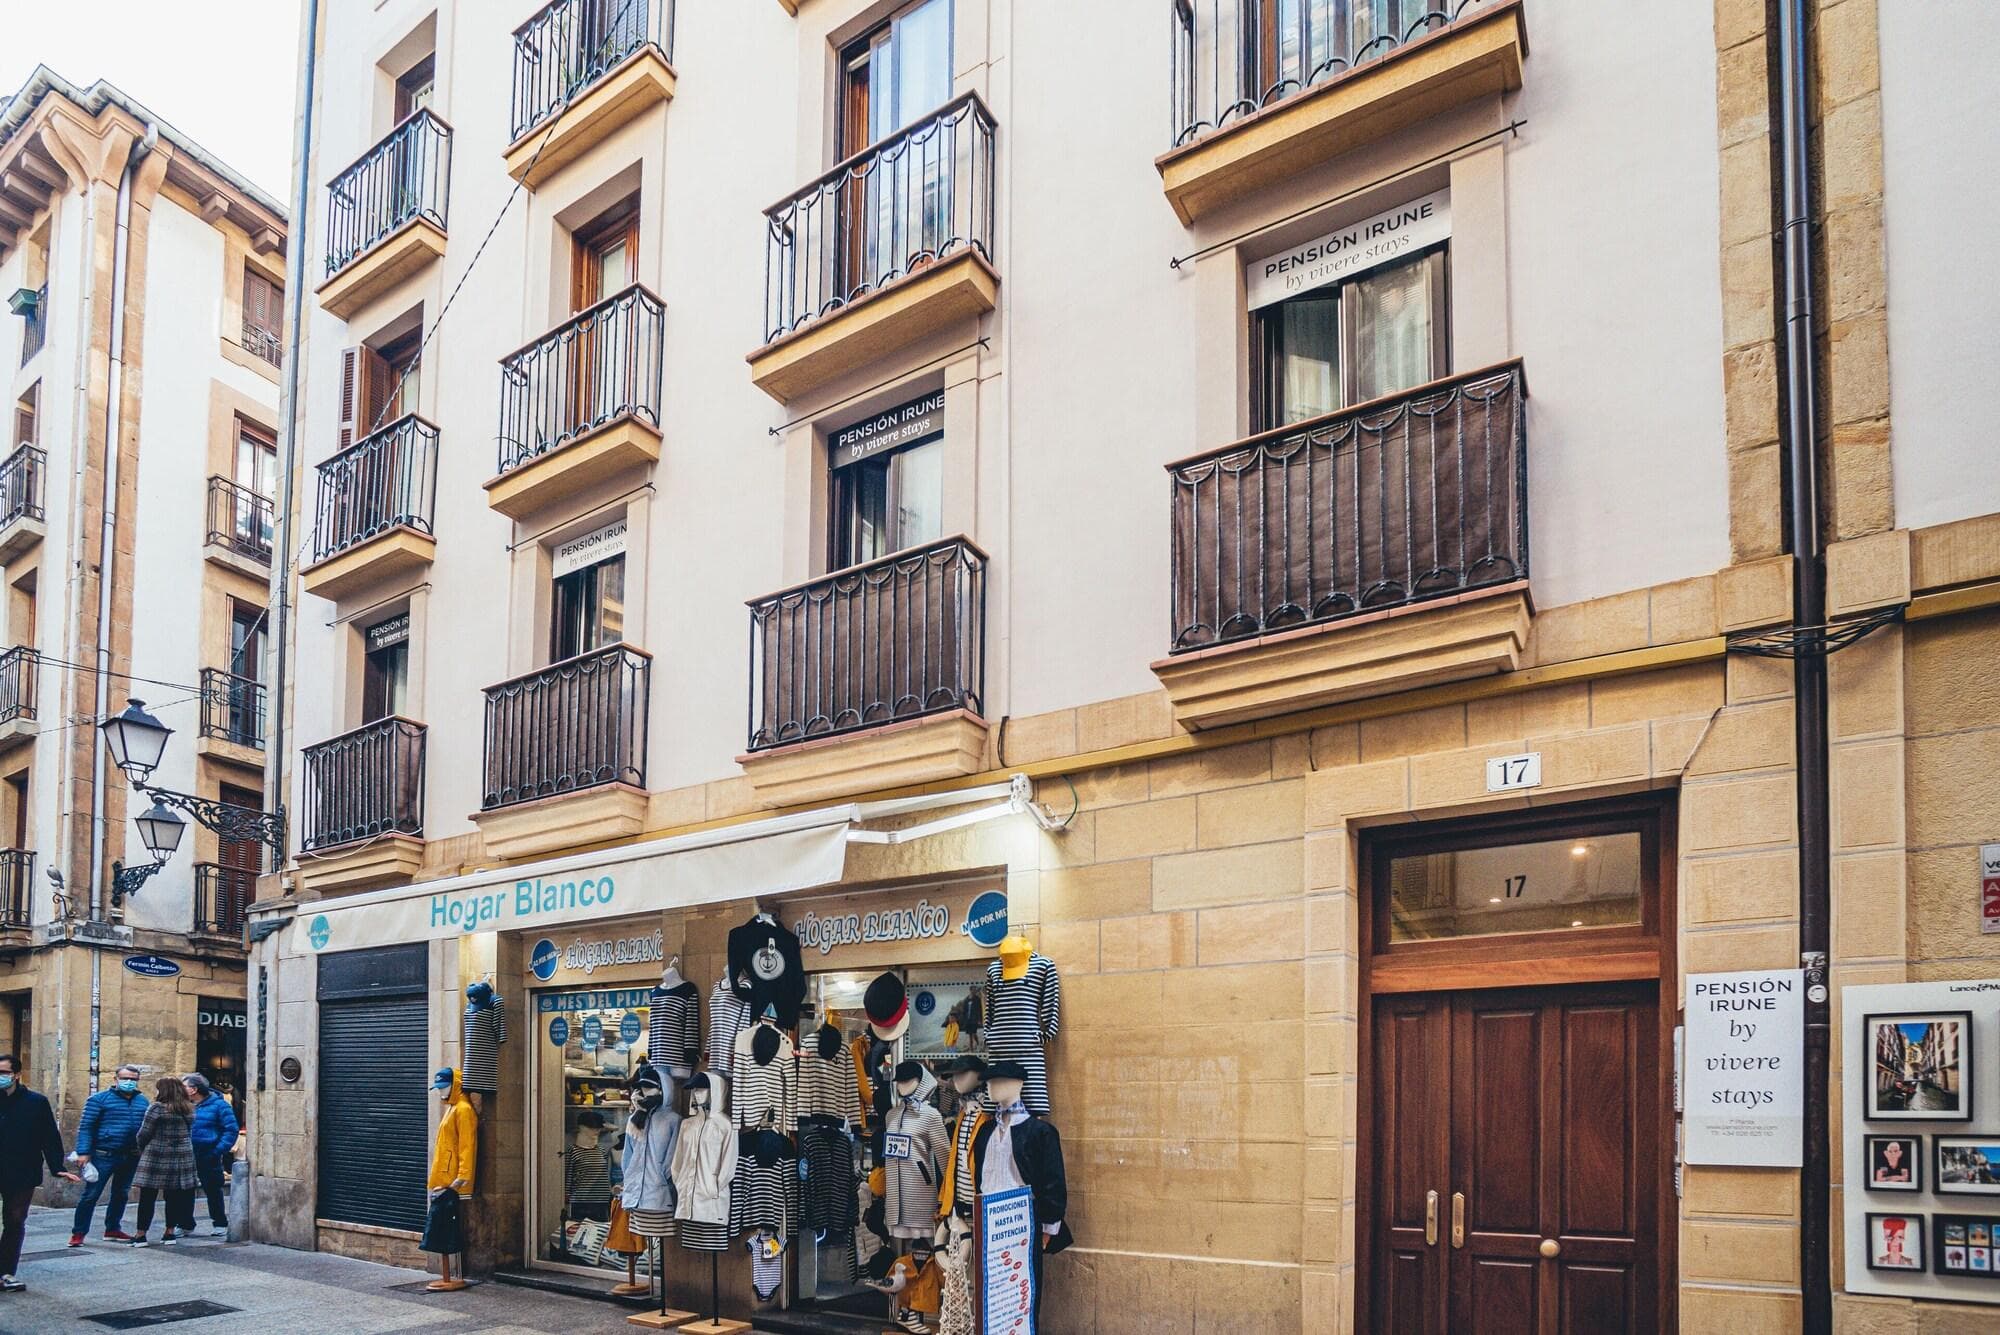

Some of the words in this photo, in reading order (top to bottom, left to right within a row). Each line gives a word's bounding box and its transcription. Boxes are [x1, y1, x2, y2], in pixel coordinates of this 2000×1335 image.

[1265, 232, 1357, 278] PENSIÓN
[1365, 202, 1433, 241] IRUNE
[1285, 273, 1304, 291] by
[1310, 253, 1360, 281] vivere
[1366, 233, 1410, 261] stays
[839, 413, 898, 446] PENSIÓN
[902, 394, 945, 422] IRUNE
[851, 443, 864, 458] by
[866, 430, 899, 450] vivere
[902, 418, 931, 438] stays
[561, 533, 602, 557] PENSIÓN
[1497, 758, 1529, 785] 17
[1504, 875, 1527, 898] 17
[430, 892, 506, 932] Hogar
[514, 876, 614, 916] Blanco
[794, 911, 861, 955] HOGAR
[863, 899, 949, 942] BLANCO
[980, 912, 995, 926] POR
[565, 938, 614, 974] HOGAR
[1695, 978, 1791, 996] PENSIÓN
[557, 995, 583, 1010] MES
[588, 993, 612, 1009] DEL
[1710, 998, 1776, 1012] IRUNE
[198, 1012, 247, 1028] DIAB
[1729, 1019, 1756, 1042] by
[1706, 1053, 1780, 1071] vivere
[1712, 1088, 1774, 1109] stays
[888, 1143, 898, 1154] 39
[989, 1199, 1027, 1216] PROMOCIONES
[994, 1216, 1013, 1228] HASTA
[1014, 1213, 1024, 1223] FIN
[991, 1225, 1027, 1242] EXISTENCIAS
